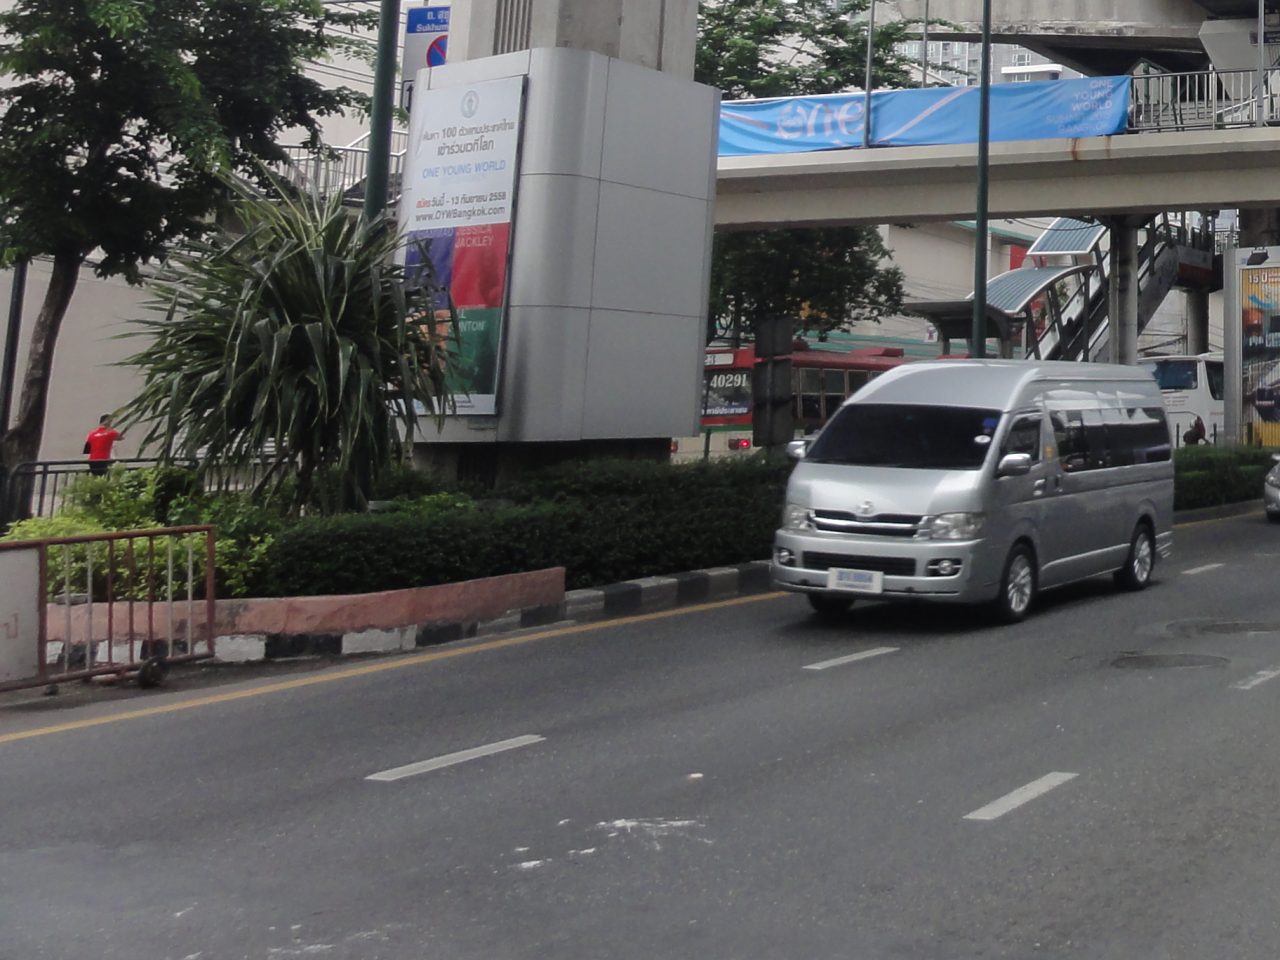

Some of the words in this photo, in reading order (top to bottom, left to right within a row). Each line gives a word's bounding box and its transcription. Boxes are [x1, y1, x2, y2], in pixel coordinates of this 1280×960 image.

[416, 23, 450, 32] Sukhum
[442, 126, 457, 139] 100
[422, 166, 441, 179] ONE
[443, 163, 472, 176] YOUNG
[475, 159, 506, 173] WORLD
[415, 206, 506, 222] www.OYWBangkok.com
[710, 374, 747, 388] 40291
